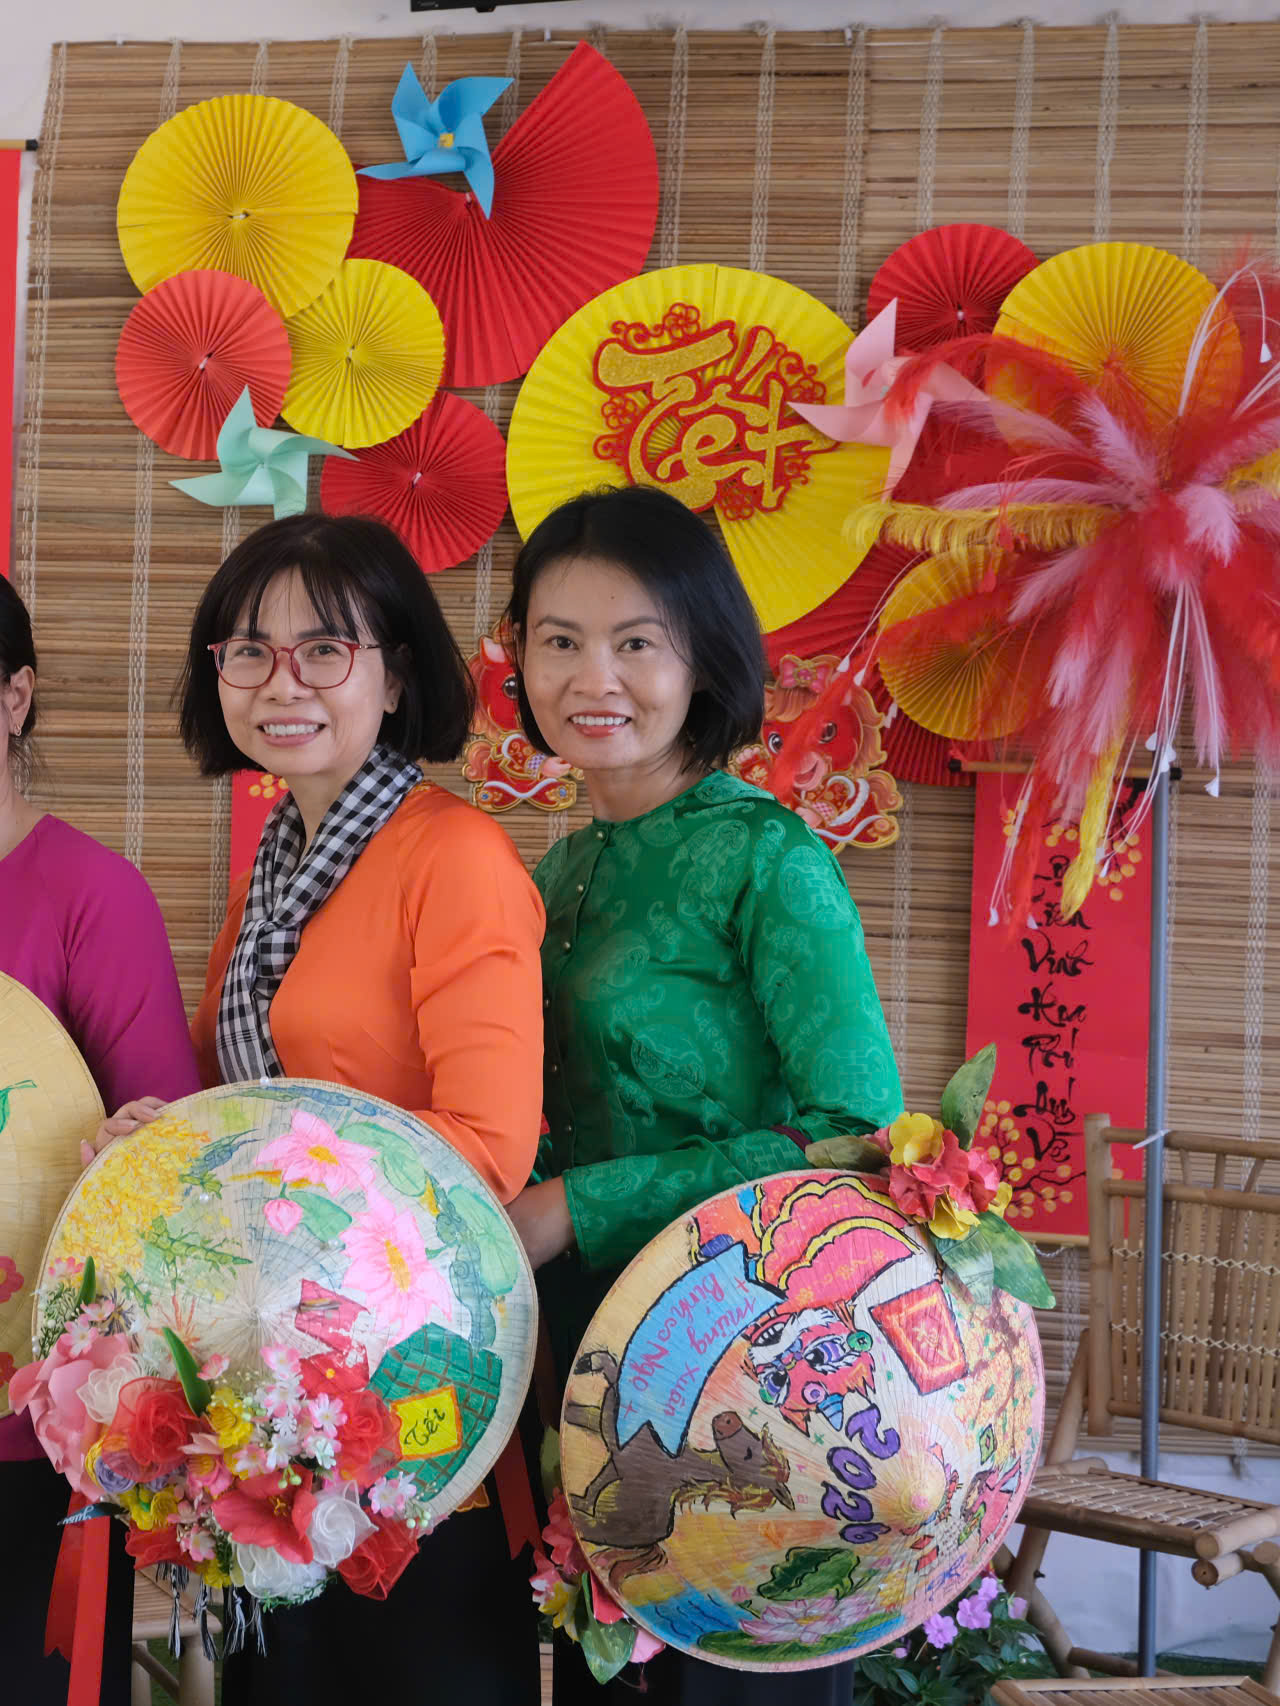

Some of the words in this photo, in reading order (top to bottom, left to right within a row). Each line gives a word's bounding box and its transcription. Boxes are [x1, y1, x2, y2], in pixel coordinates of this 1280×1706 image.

[596, 324, 836, 512] Tết
[1021, 930, 1095, 977] Vinh
[403, 1408, 445, 1446] Tết
[821, 1403, 901, 1545] 2026
